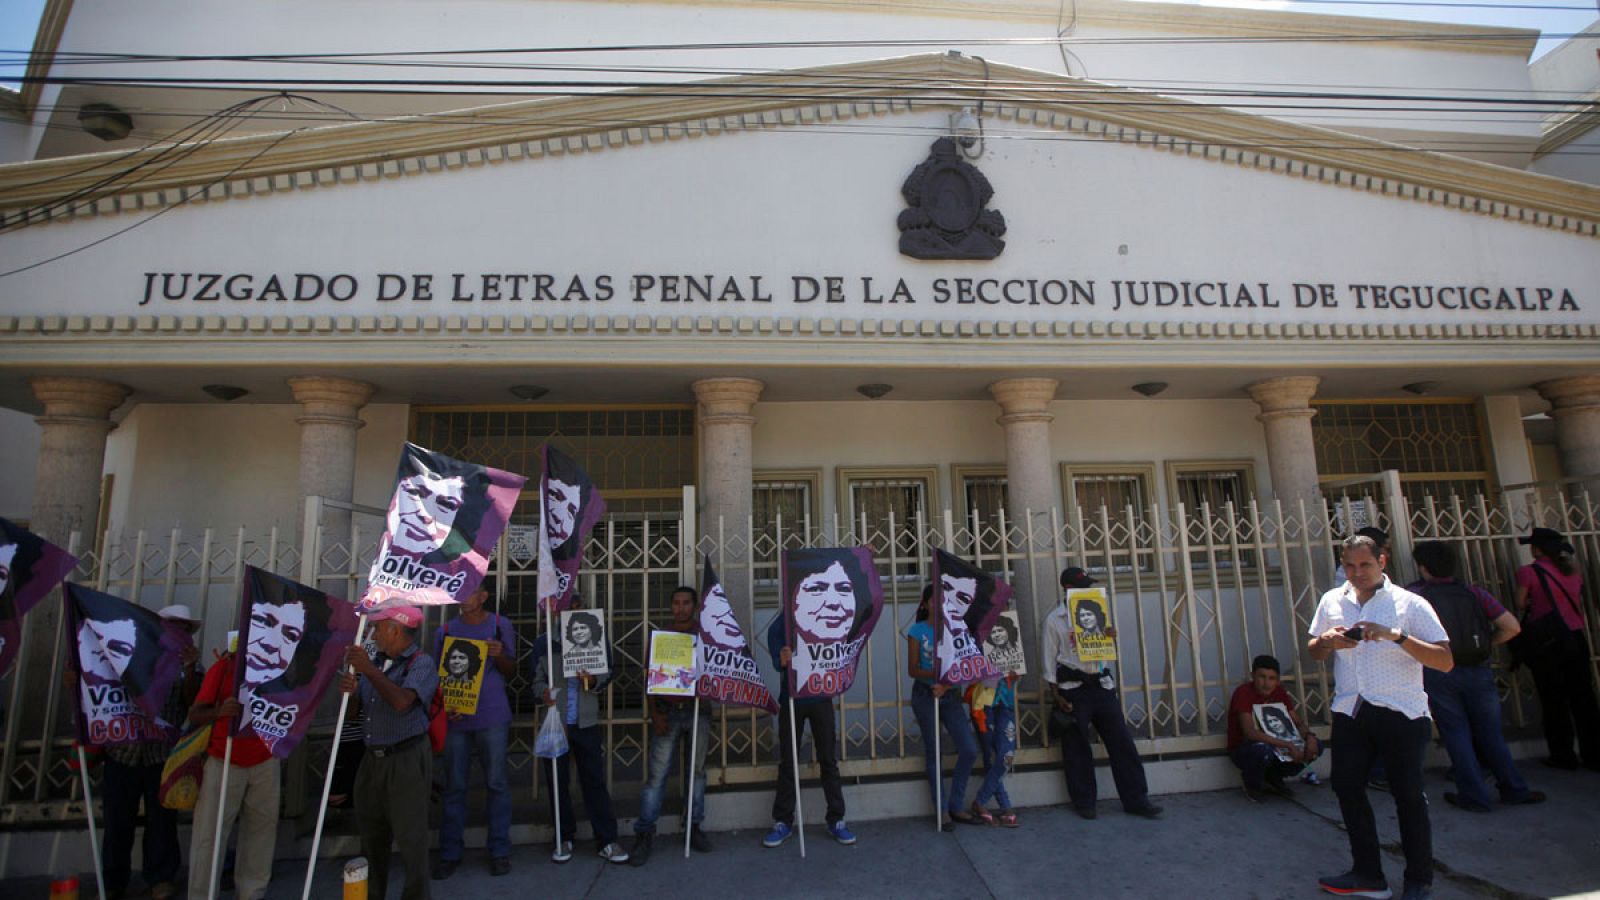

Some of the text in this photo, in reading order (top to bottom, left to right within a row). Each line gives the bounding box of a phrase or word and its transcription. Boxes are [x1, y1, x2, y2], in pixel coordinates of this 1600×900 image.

[138, 273, 1581, 312] JUZGADO DE LETRAS PENAL DE LA SECCION JUDICIAL DE TEGUCIGALPA
[381, 551, 465, 593] olveré
[810, 663, 816, 671] y
[698, 673, 770, 705] COPINH
